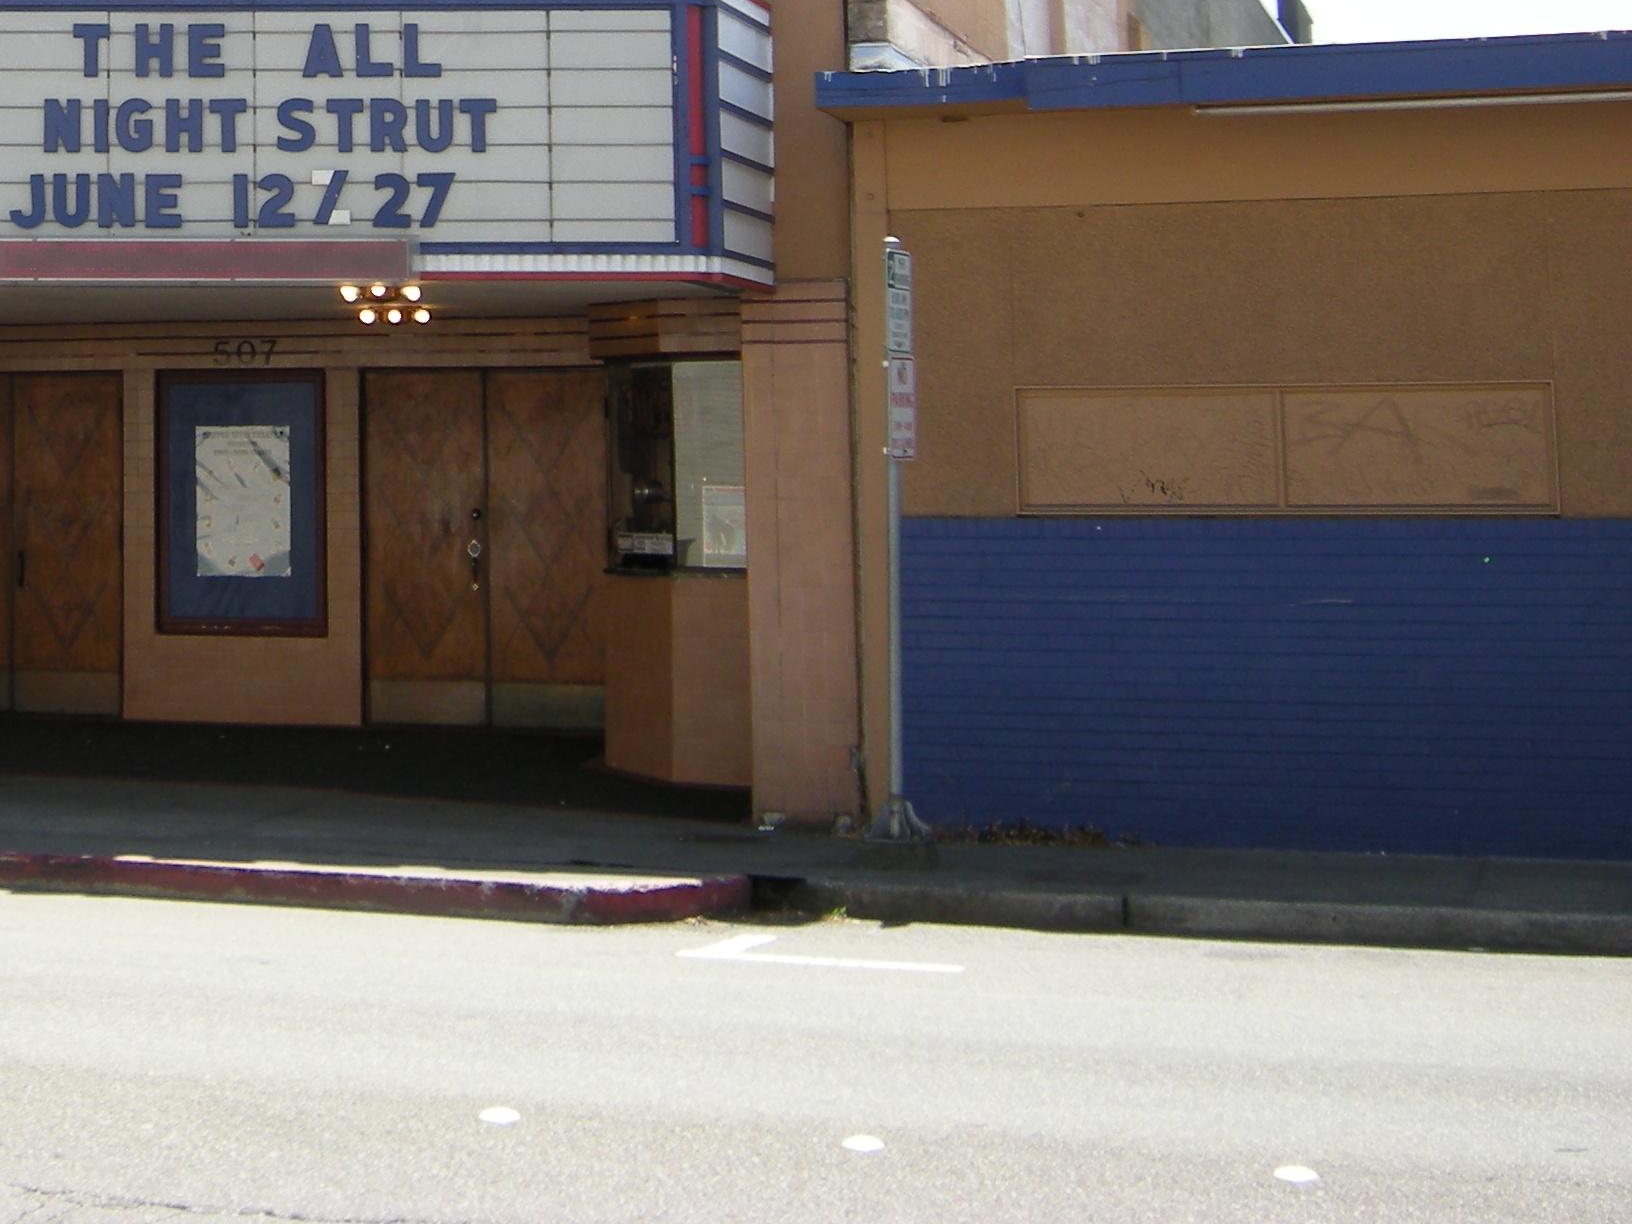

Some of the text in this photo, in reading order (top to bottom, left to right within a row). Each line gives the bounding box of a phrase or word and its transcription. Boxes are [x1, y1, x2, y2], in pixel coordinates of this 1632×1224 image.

[72, 23, 443, 78] THE ALL
[43, 98, 498, 154] NIGHT STRUT
[9, 173, 183, 230] JUNE
[213, 339, 278, 366] 507
